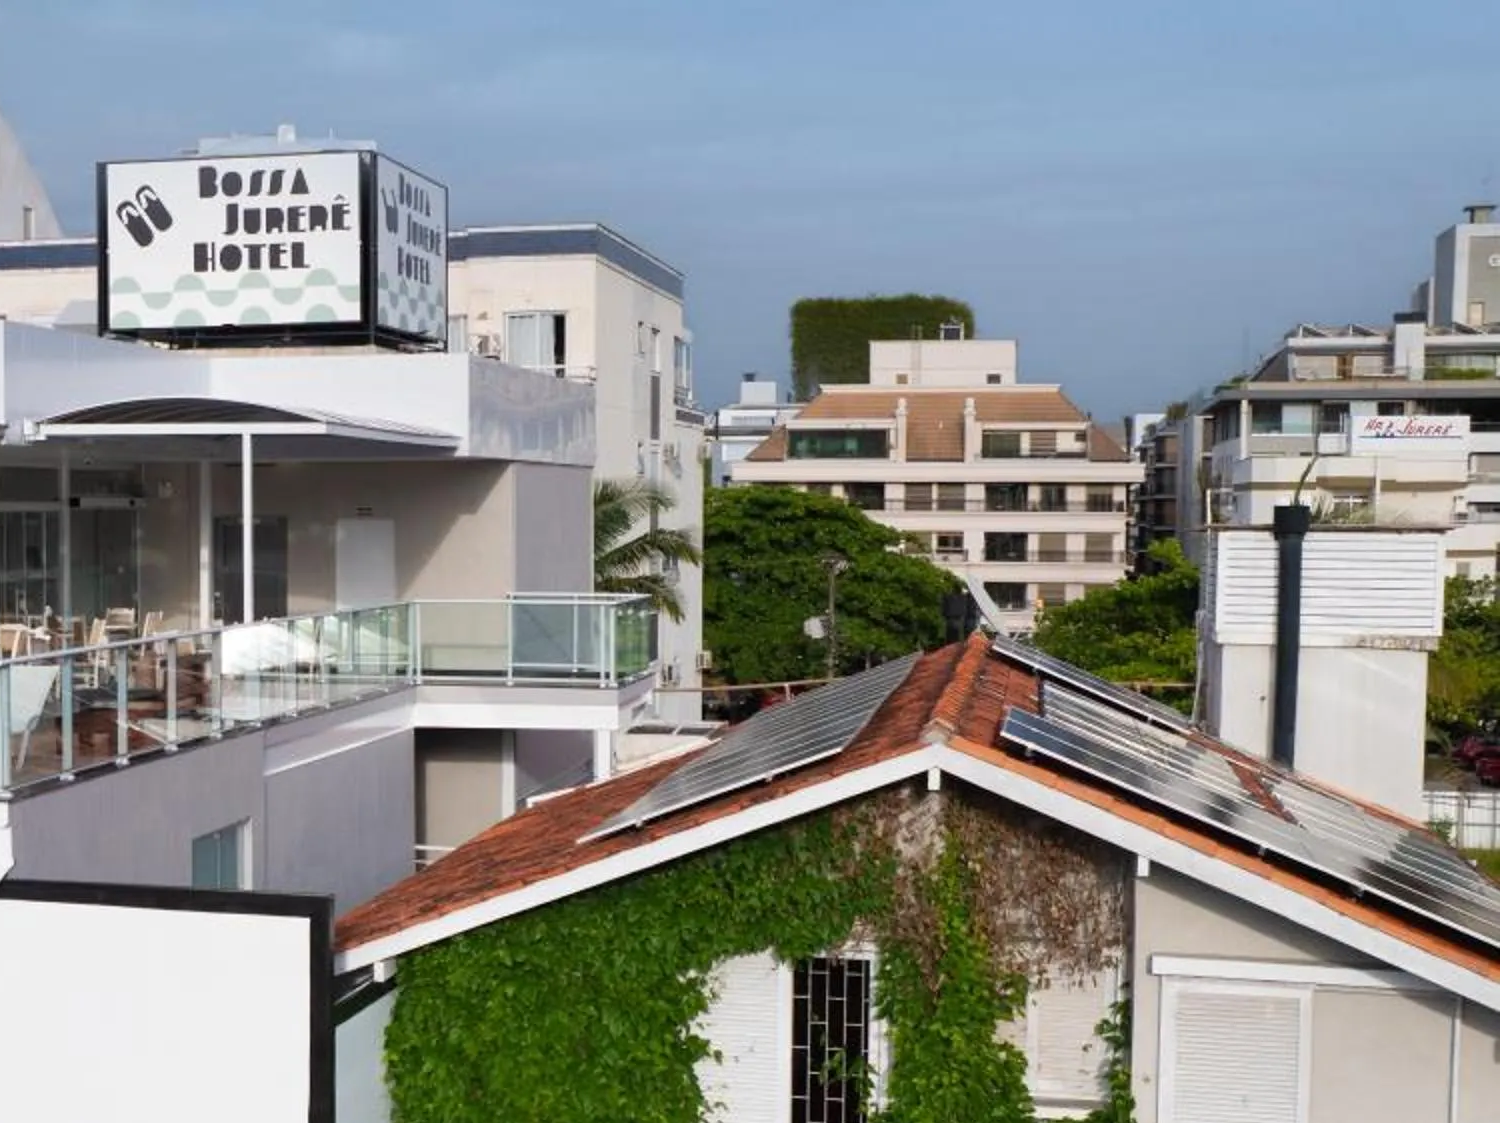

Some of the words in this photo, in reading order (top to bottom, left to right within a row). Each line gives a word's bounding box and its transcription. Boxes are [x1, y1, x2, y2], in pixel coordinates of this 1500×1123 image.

[198, 166, 310, 198] BOSSA
[223, 194, 351, 235] JURERÊ
[193, 241, 311, 272] HOTEL
